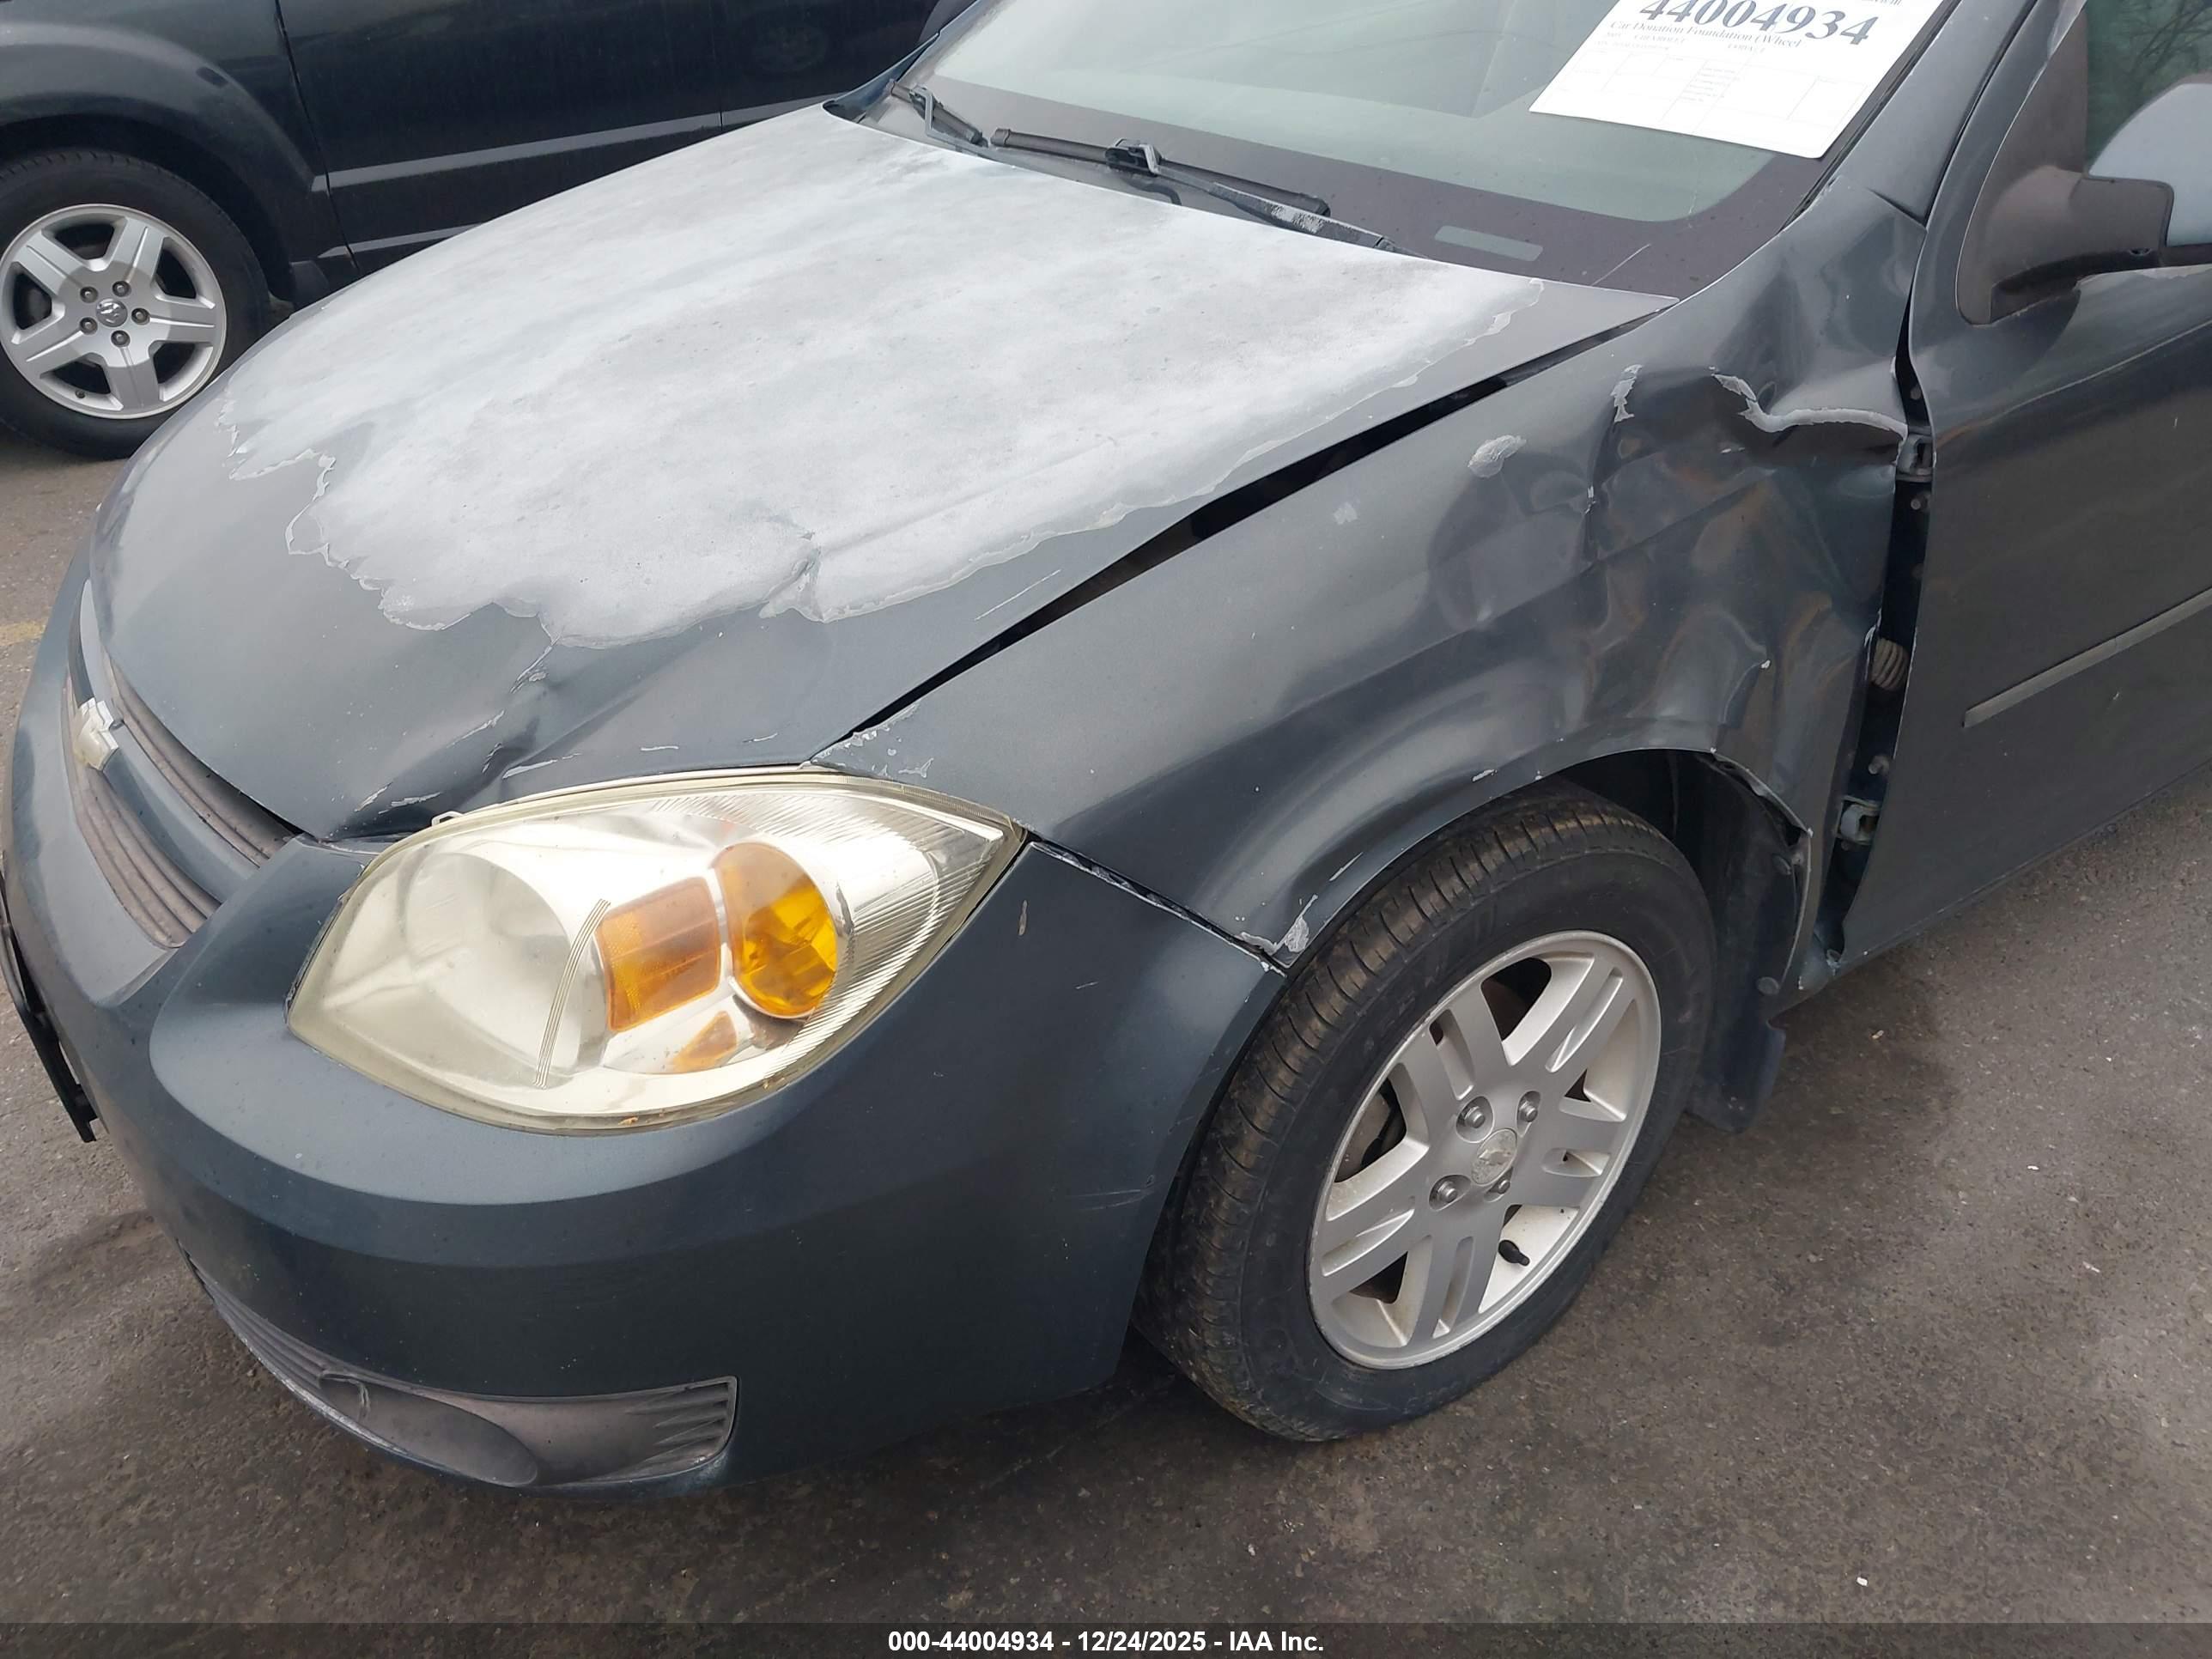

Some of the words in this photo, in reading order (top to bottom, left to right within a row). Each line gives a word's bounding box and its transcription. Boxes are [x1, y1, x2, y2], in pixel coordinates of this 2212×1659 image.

[1610, 21, 1630, 29] Car
[1632, 21, 1684, 34] Donation
[1686, 27, 1752, 40] Foundation
[1639, 0, 1879, 46] 44004934
